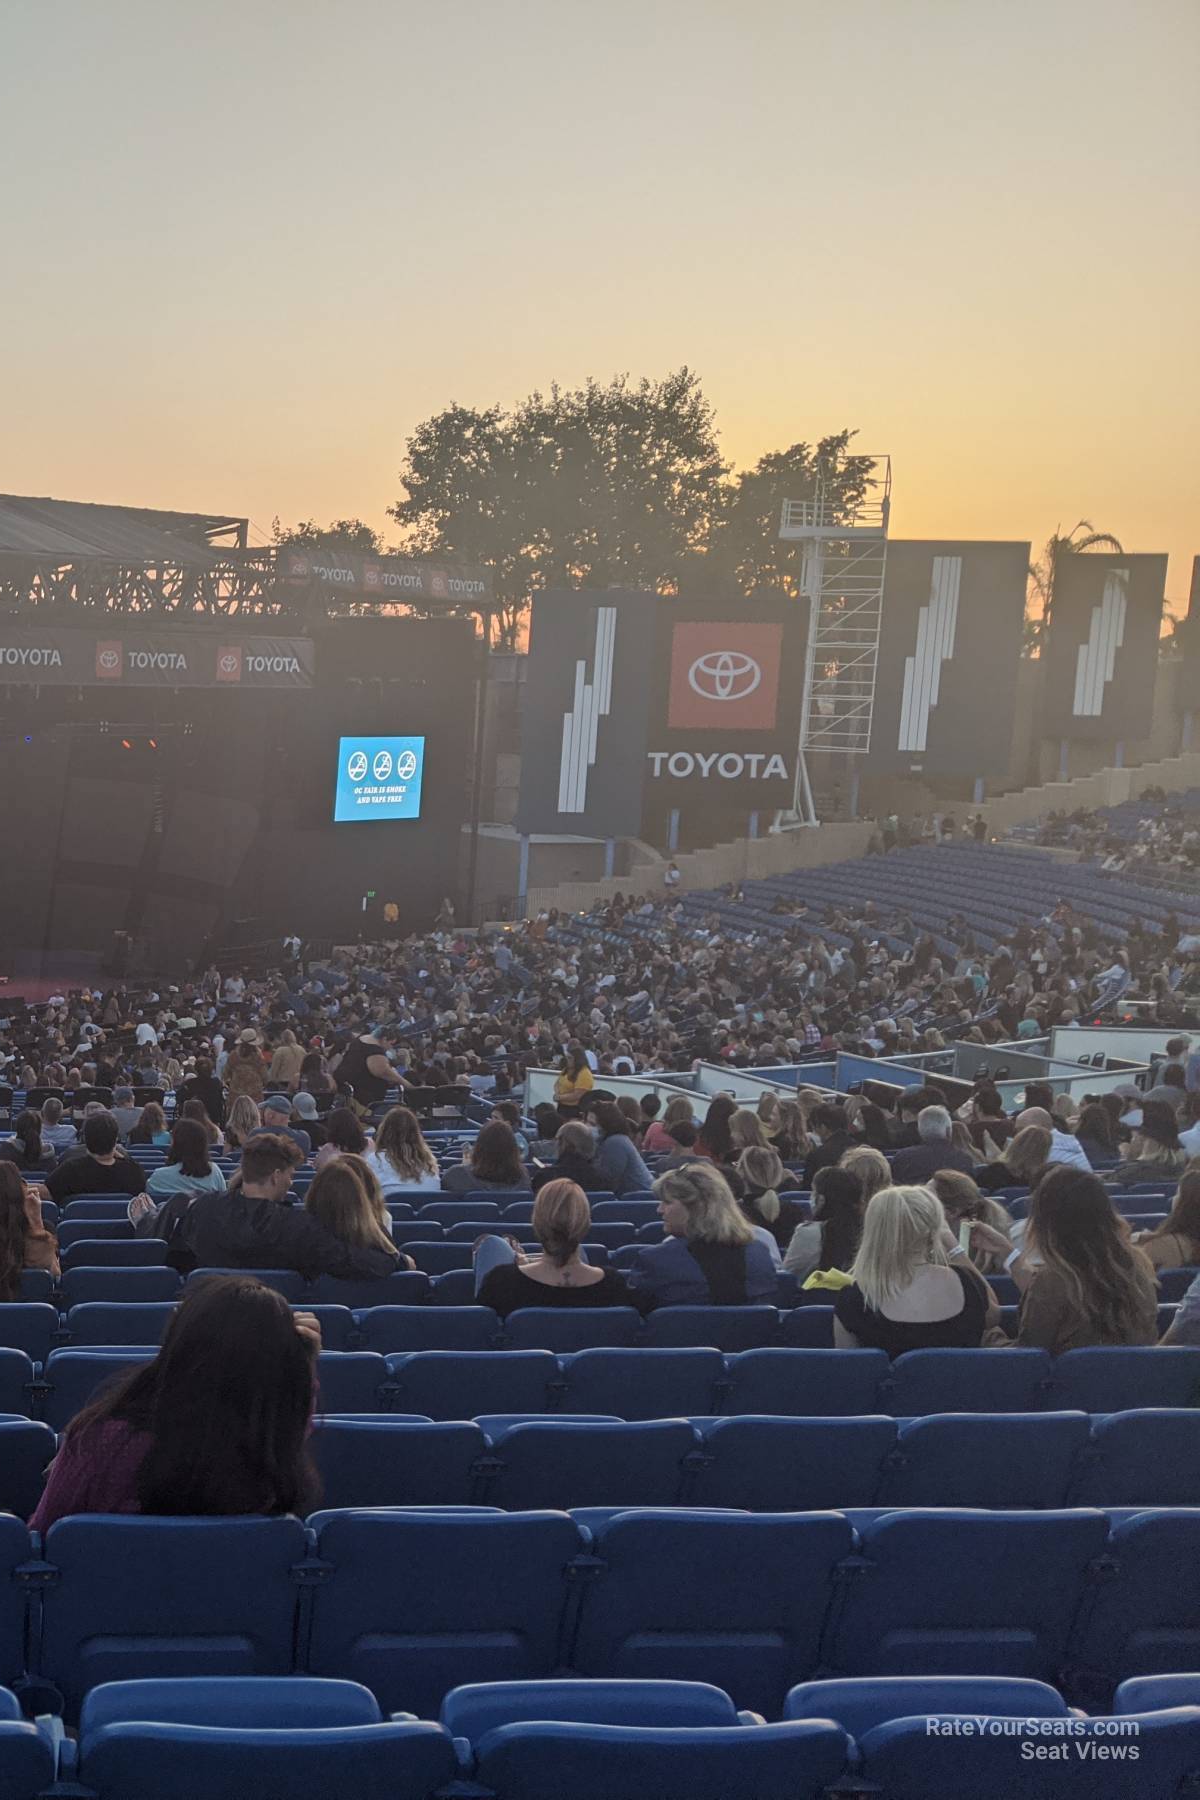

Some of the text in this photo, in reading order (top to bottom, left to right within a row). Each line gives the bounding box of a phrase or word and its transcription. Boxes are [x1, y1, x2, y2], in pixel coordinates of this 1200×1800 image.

[312, 565, 486, 593] TOYOTA TOYOTA TOYOTA
[128, 651, 188, 670] TOYOTA
[246, 656, 301, 673] TOYOTA
[647, 751, 789, 780] TOYOTA
